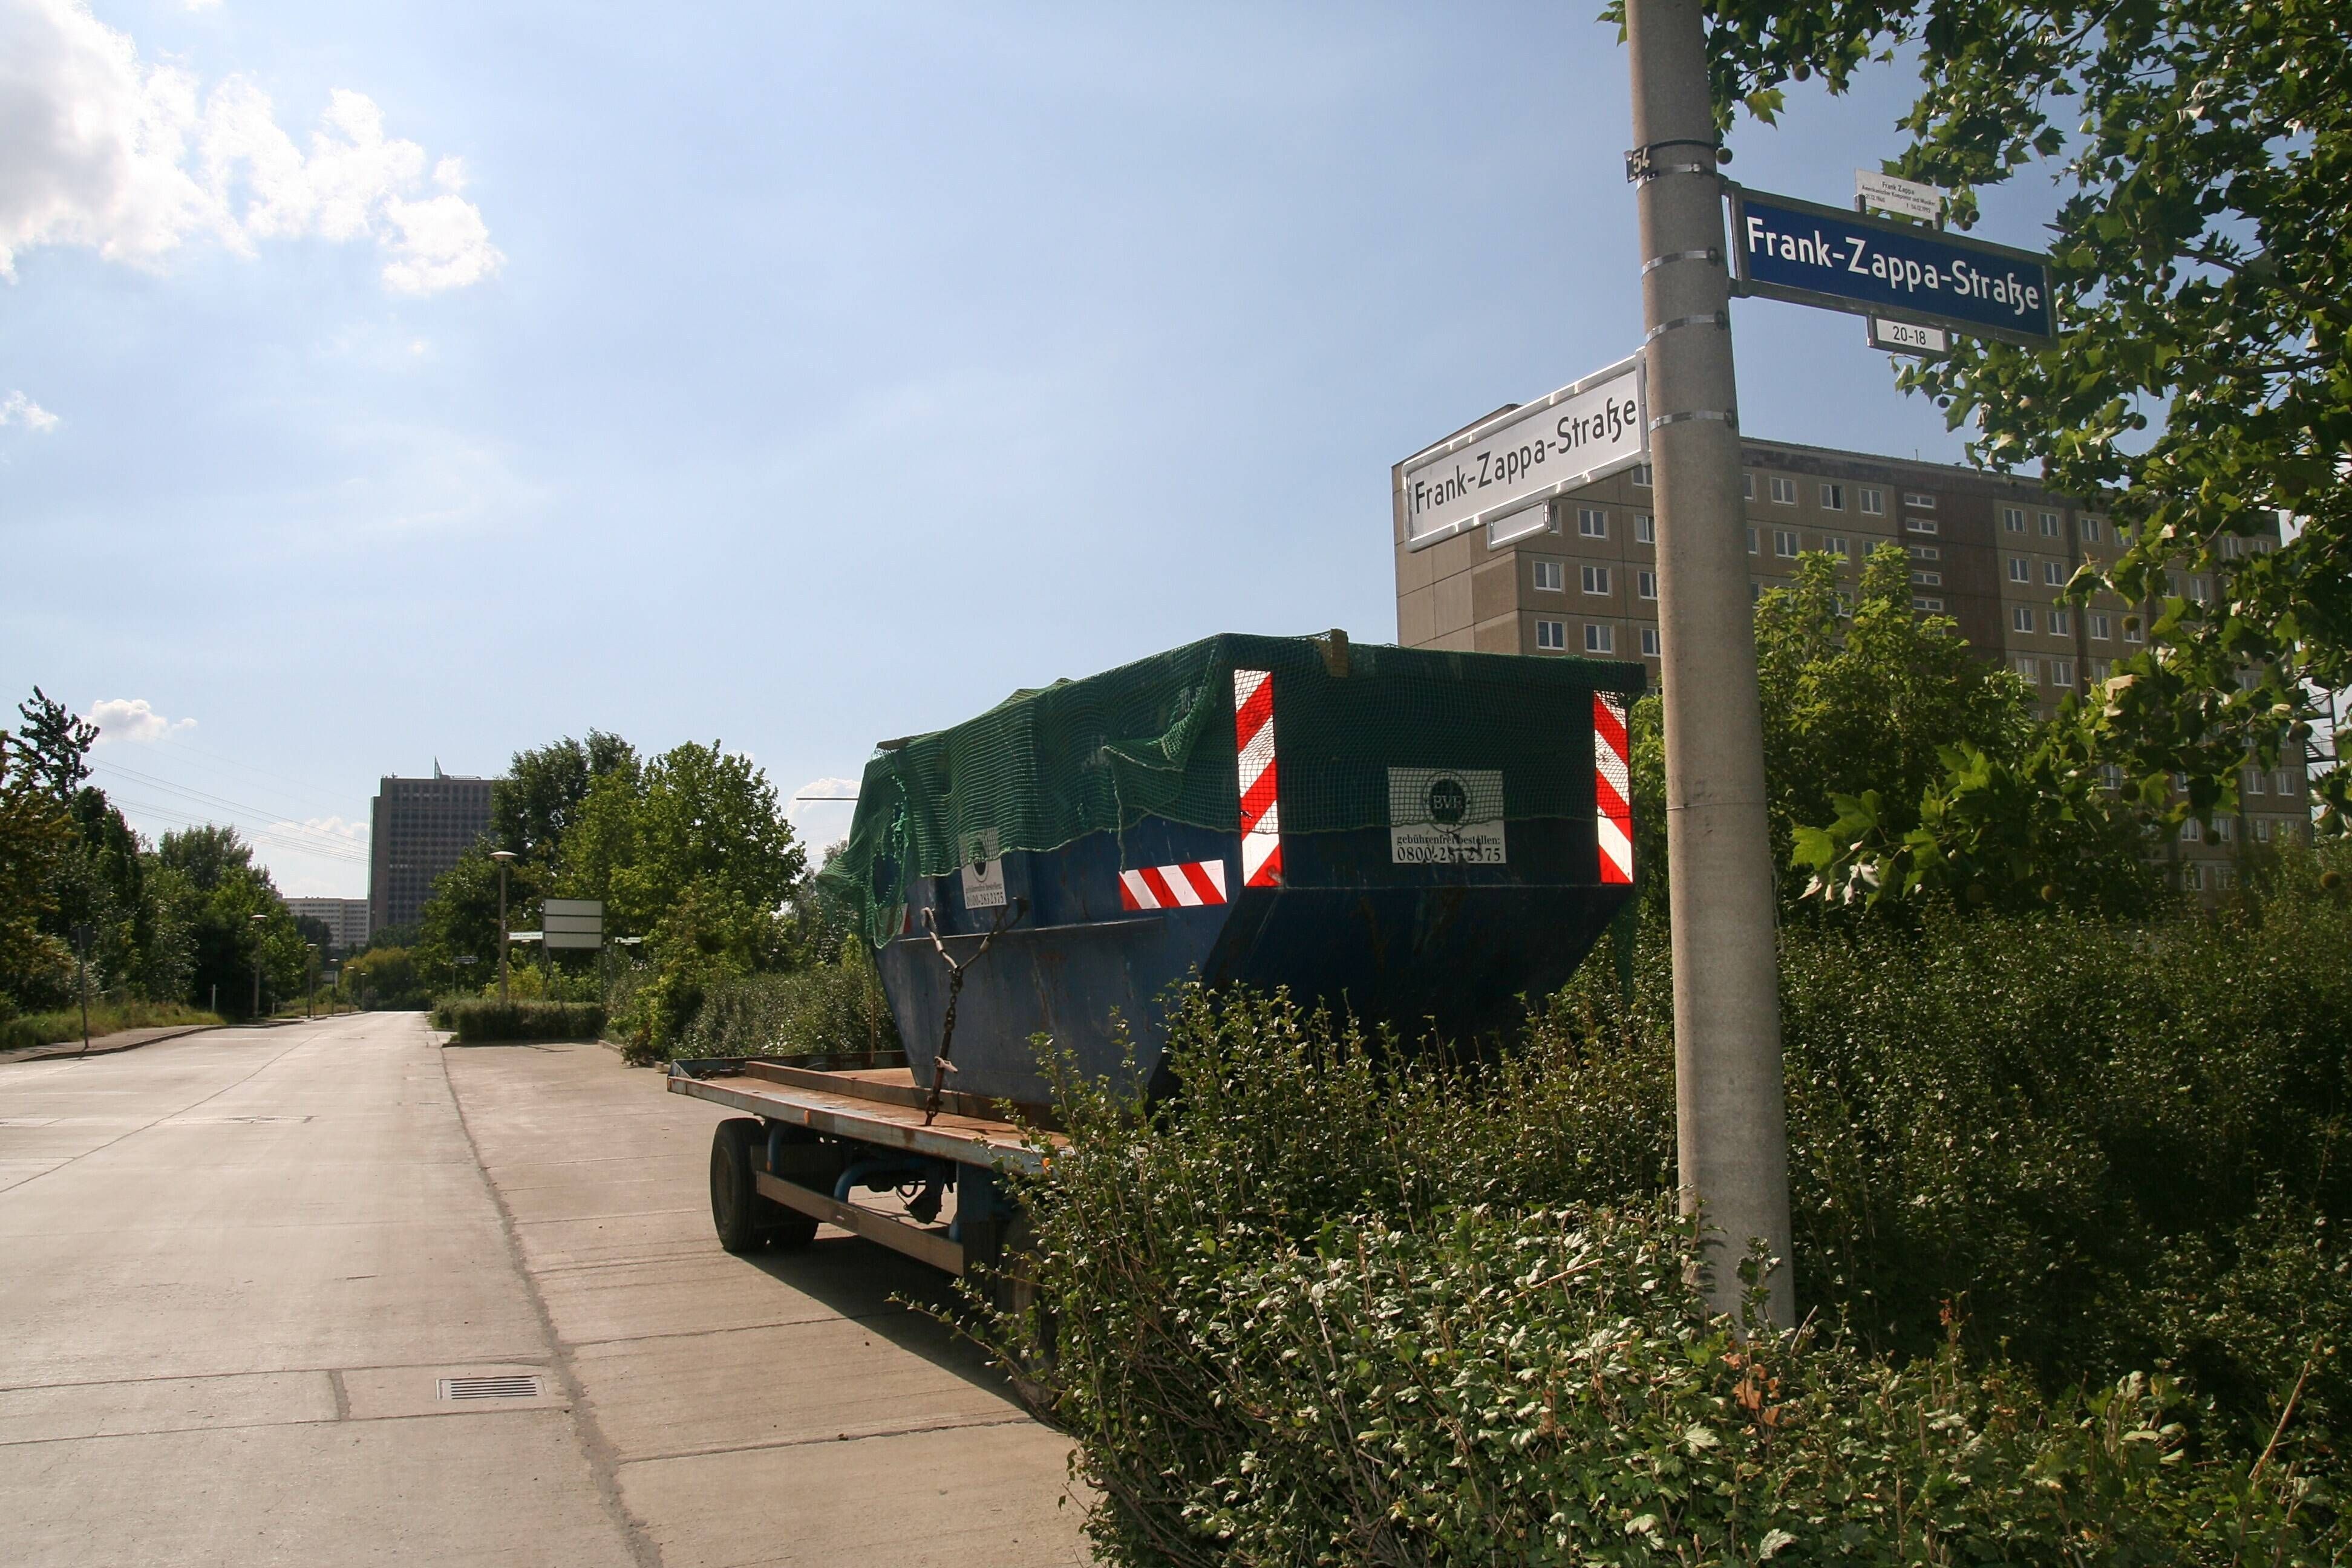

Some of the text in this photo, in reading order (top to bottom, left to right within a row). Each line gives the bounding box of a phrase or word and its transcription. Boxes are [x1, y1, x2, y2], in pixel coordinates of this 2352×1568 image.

[1633, 146, 1650, 173] 54
[1881, 181, 1915, 195] Frank Zappa
[1746, 216, 2039, 316] Frank-Zappa-Straße
[1892, 325, 1926, 345] 20-18
[1414, 397, 1636, 514] Frank-Zappa-Straße
